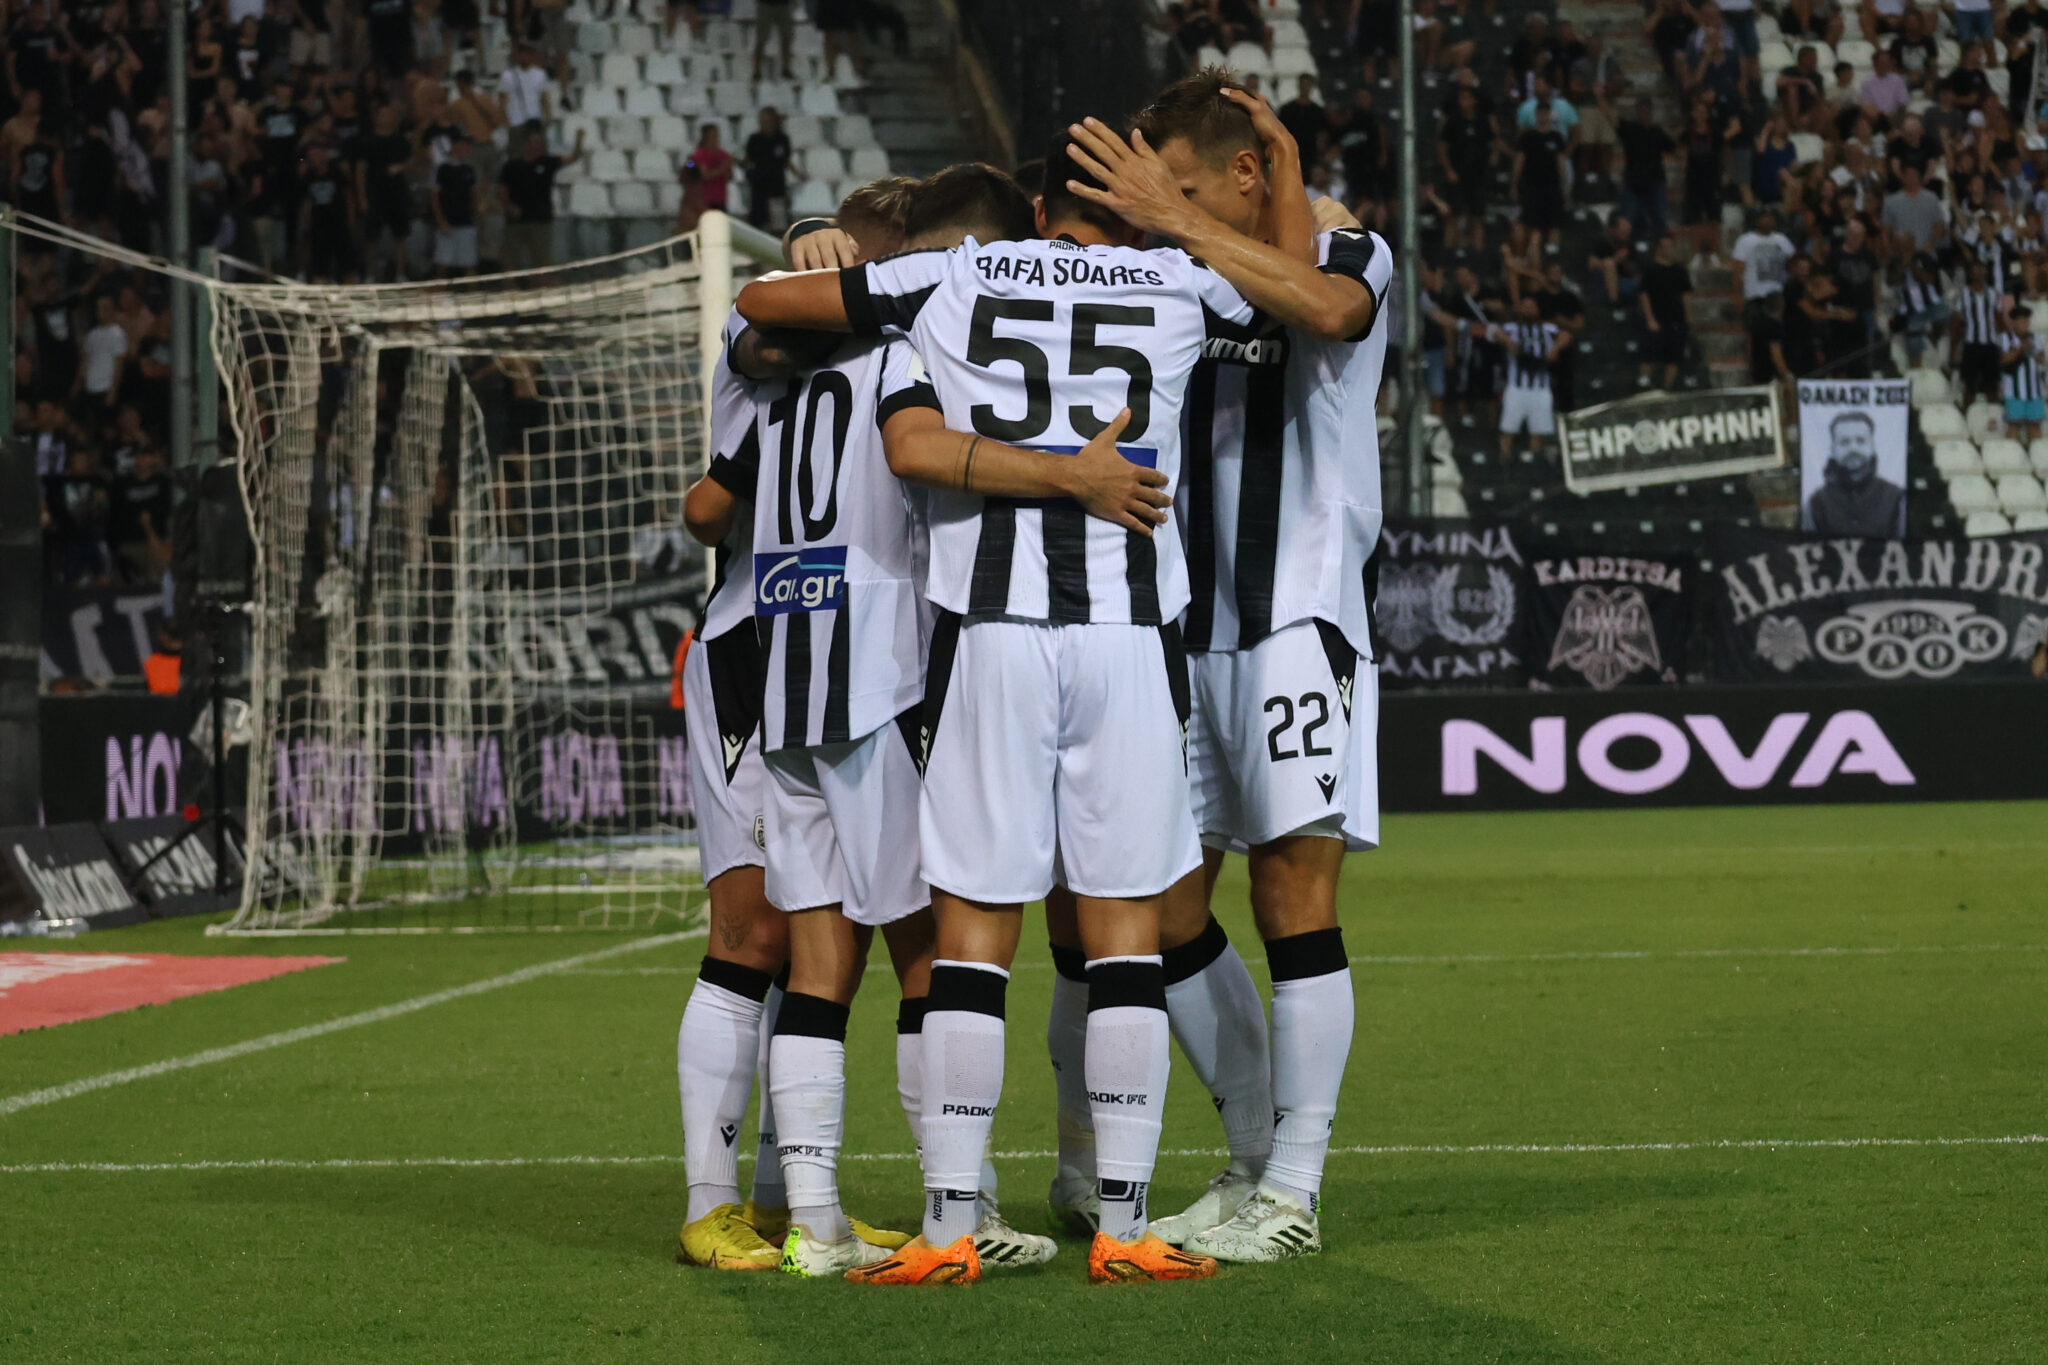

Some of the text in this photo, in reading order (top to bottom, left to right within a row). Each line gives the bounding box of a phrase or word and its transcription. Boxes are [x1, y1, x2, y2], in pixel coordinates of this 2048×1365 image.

[976, 256, 1164, 287] RAFA SOARES
[965, 295, 1156, 443] 55
[1201, 337, 1282, 364] ximan
[768, 371, 853, 545] 10
[1721, 538, 2048, 625] ALEXANDR
[1263, 692, 1332, 762] 22
[1441, 709, 1917, 796] NOVA
[105, 730, 182, 822] NO
[942, 1104, 992, 1116] PAOK
[1088, 1091, 1147, 1105] AOK FC
[932, 1191, 943, 1222] SIGN
